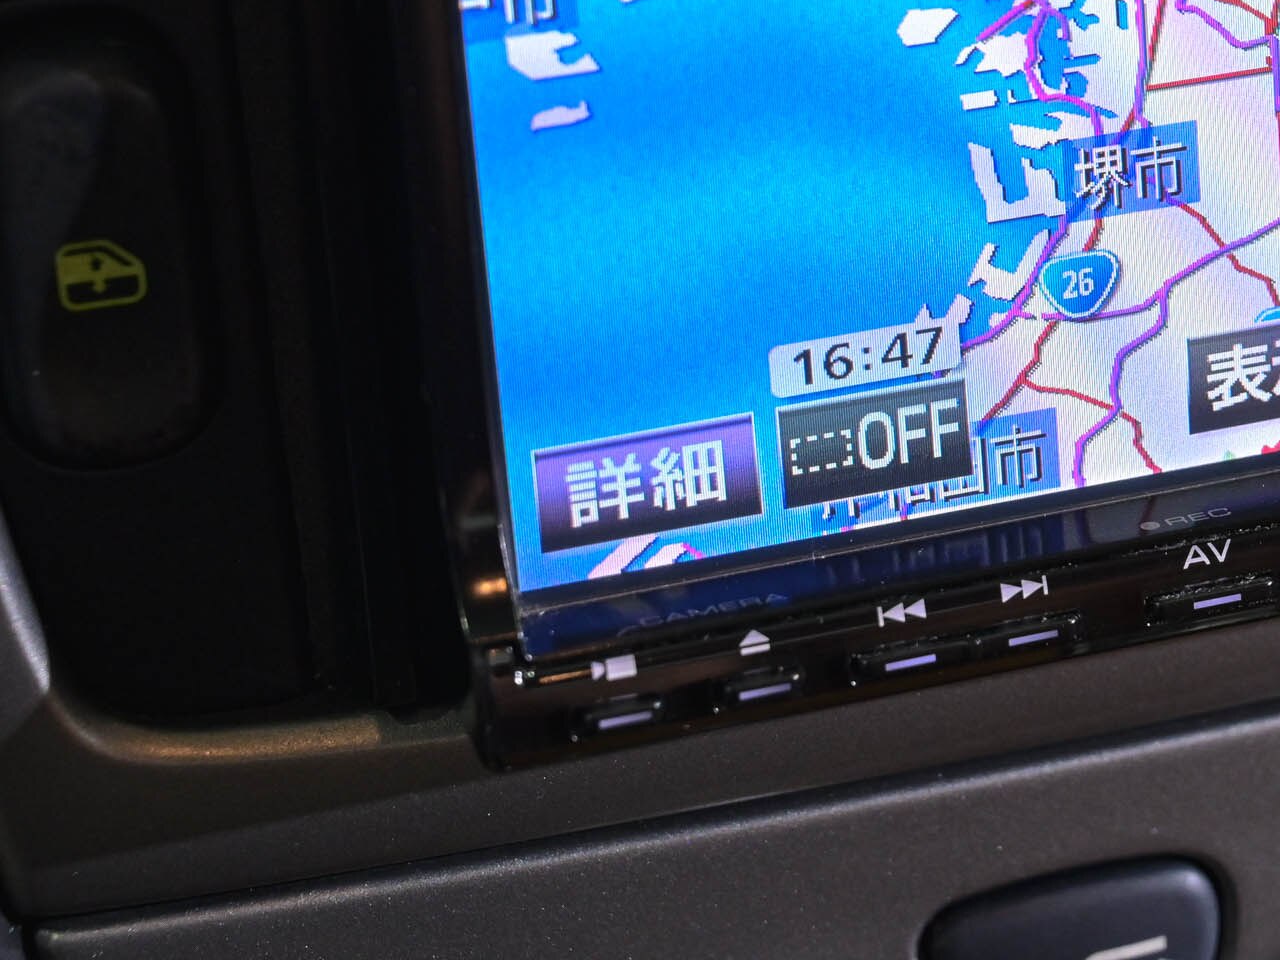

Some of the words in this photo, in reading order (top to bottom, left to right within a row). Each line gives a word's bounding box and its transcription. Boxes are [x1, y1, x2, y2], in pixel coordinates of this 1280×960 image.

[1074, 134, 1189, 212] 堺市
[1060, 266, 1096, 302] 26
[792, 324, 946, 388] 16:47
[857, 397, 962, 471] OFF
[564, 438, 729, 529] 詳細
[1164, 506, 1232, 527] REC
[1182, 539, 1234, 571] AV
